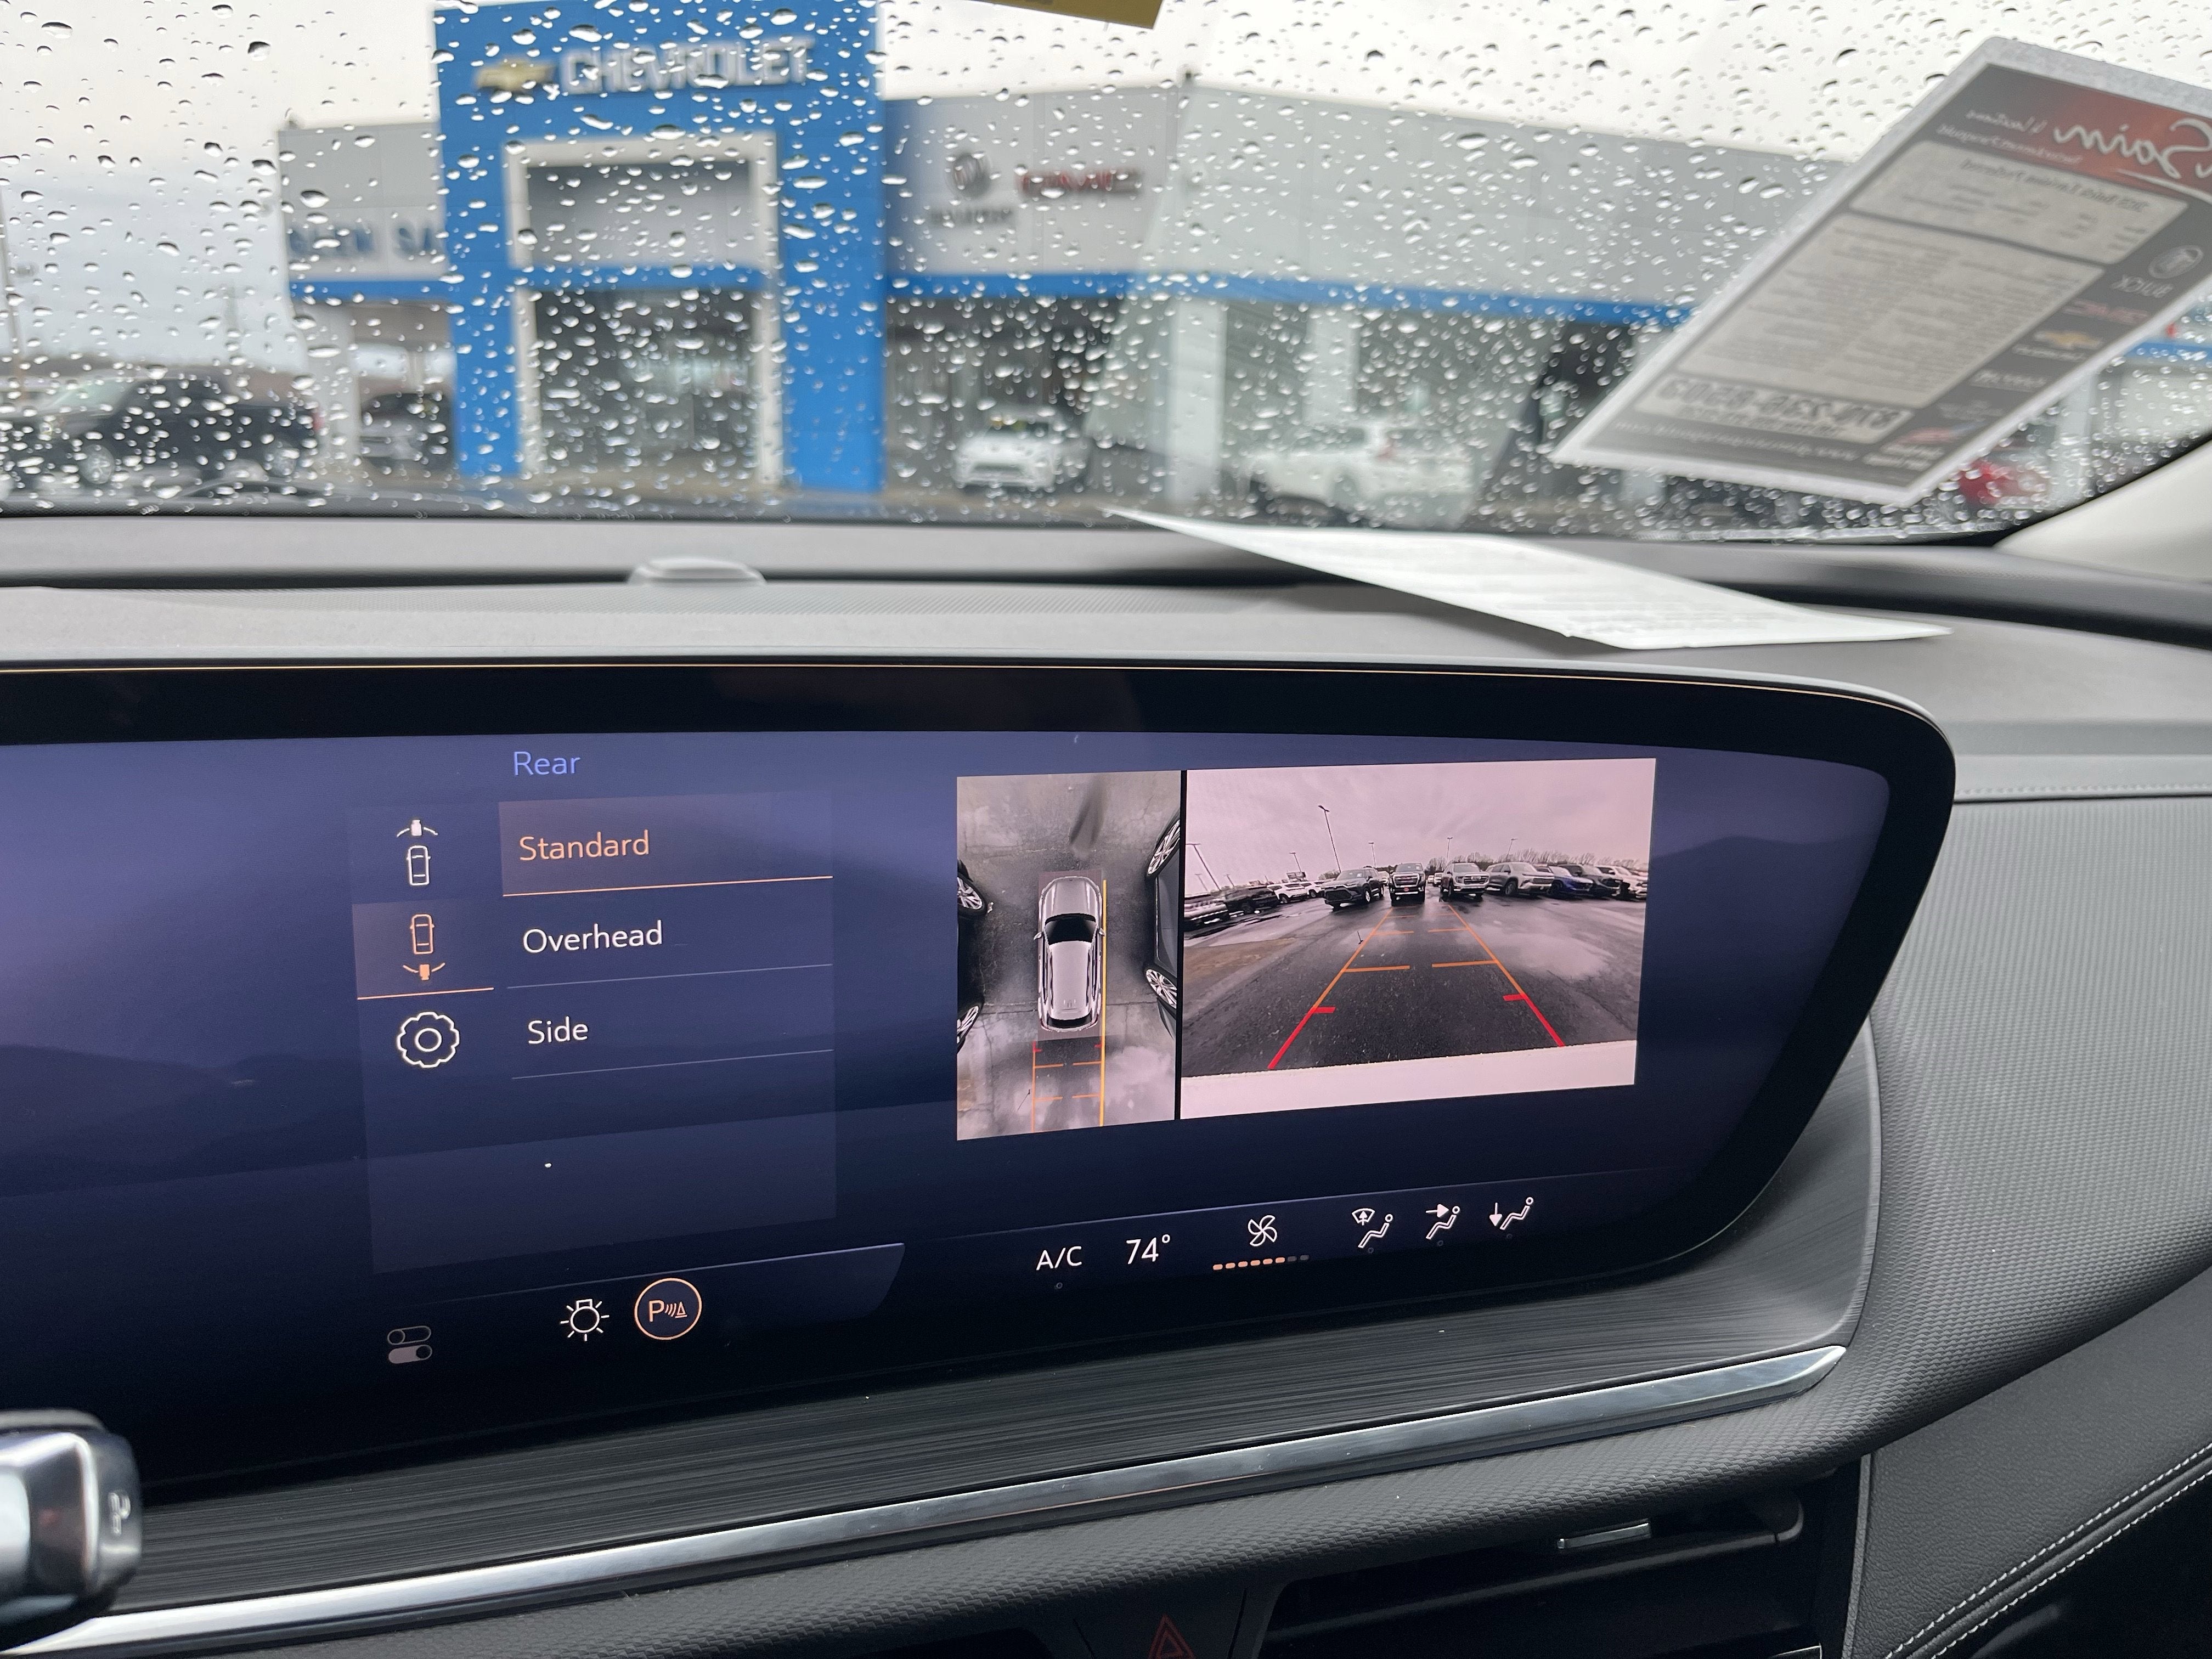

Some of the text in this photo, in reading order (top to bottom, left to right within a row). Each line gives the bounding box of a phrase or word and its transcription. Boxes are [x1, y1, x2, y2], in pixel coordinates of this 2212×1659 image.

[560, 35, 816, 96] CHEVROLET
[513, 751, 580, 776] Rear
[518, 830, 650, 861] Standard
[523, 919, 663, 953] Overhead
[527, 1016, 589, 1045] Side
[1036, 1245, 1082, 1270] A/C
[1125, 1234, 1171, 1264] 74°
